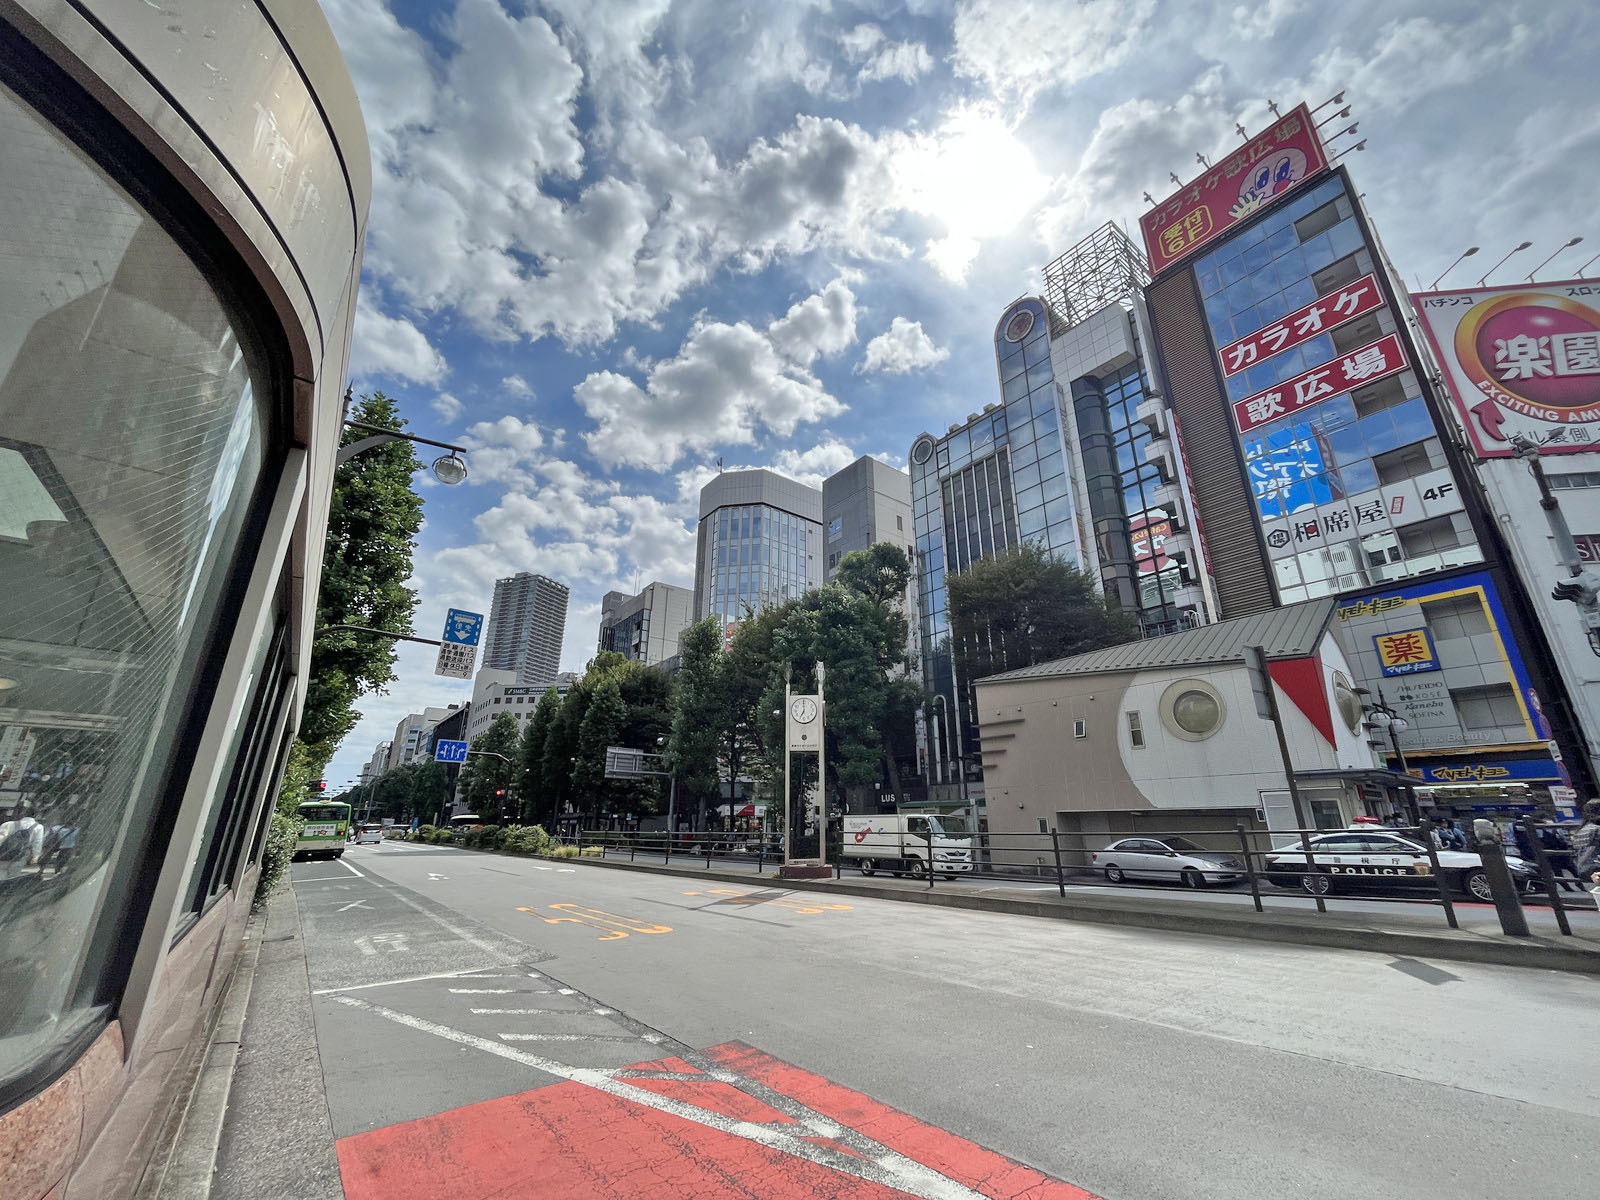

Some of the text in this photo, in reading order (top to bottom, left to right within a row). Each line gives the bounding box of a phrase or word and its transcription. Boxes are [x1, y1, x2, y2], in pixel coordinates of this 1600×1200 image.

[1164, 209, 1203, 244] 受付
[1168, 224, 1204, 252] 6F
[1424, 296, 1474, 308] パチンコ
[1228, 286, 1369, 370] カラオケ
[1495, 330, 1600, 381] 楽園
[1245, 345, 1387, 424] 歌広場
[1476, 380, 1559, 422] EXCITING
[1294, 499, 1387, 543] 相席屋
[1422, 483, 1454, 501] 4F
[1383, 633, 1425, 664] 薬
[1386, 662, 1433, 674] マツモトキヨシ
[1393, 681, 1443, 694] SHISEIDO
[1404, 700, 1444, 711] Kanebo
[1408, 710, 1446, 720] SOFINA
[1446, 731, 1491, 744] Beauty
[1431, 764, 1510, 781] マツモトキヨシ
[1330, 866, 1407, 876] POLICE
